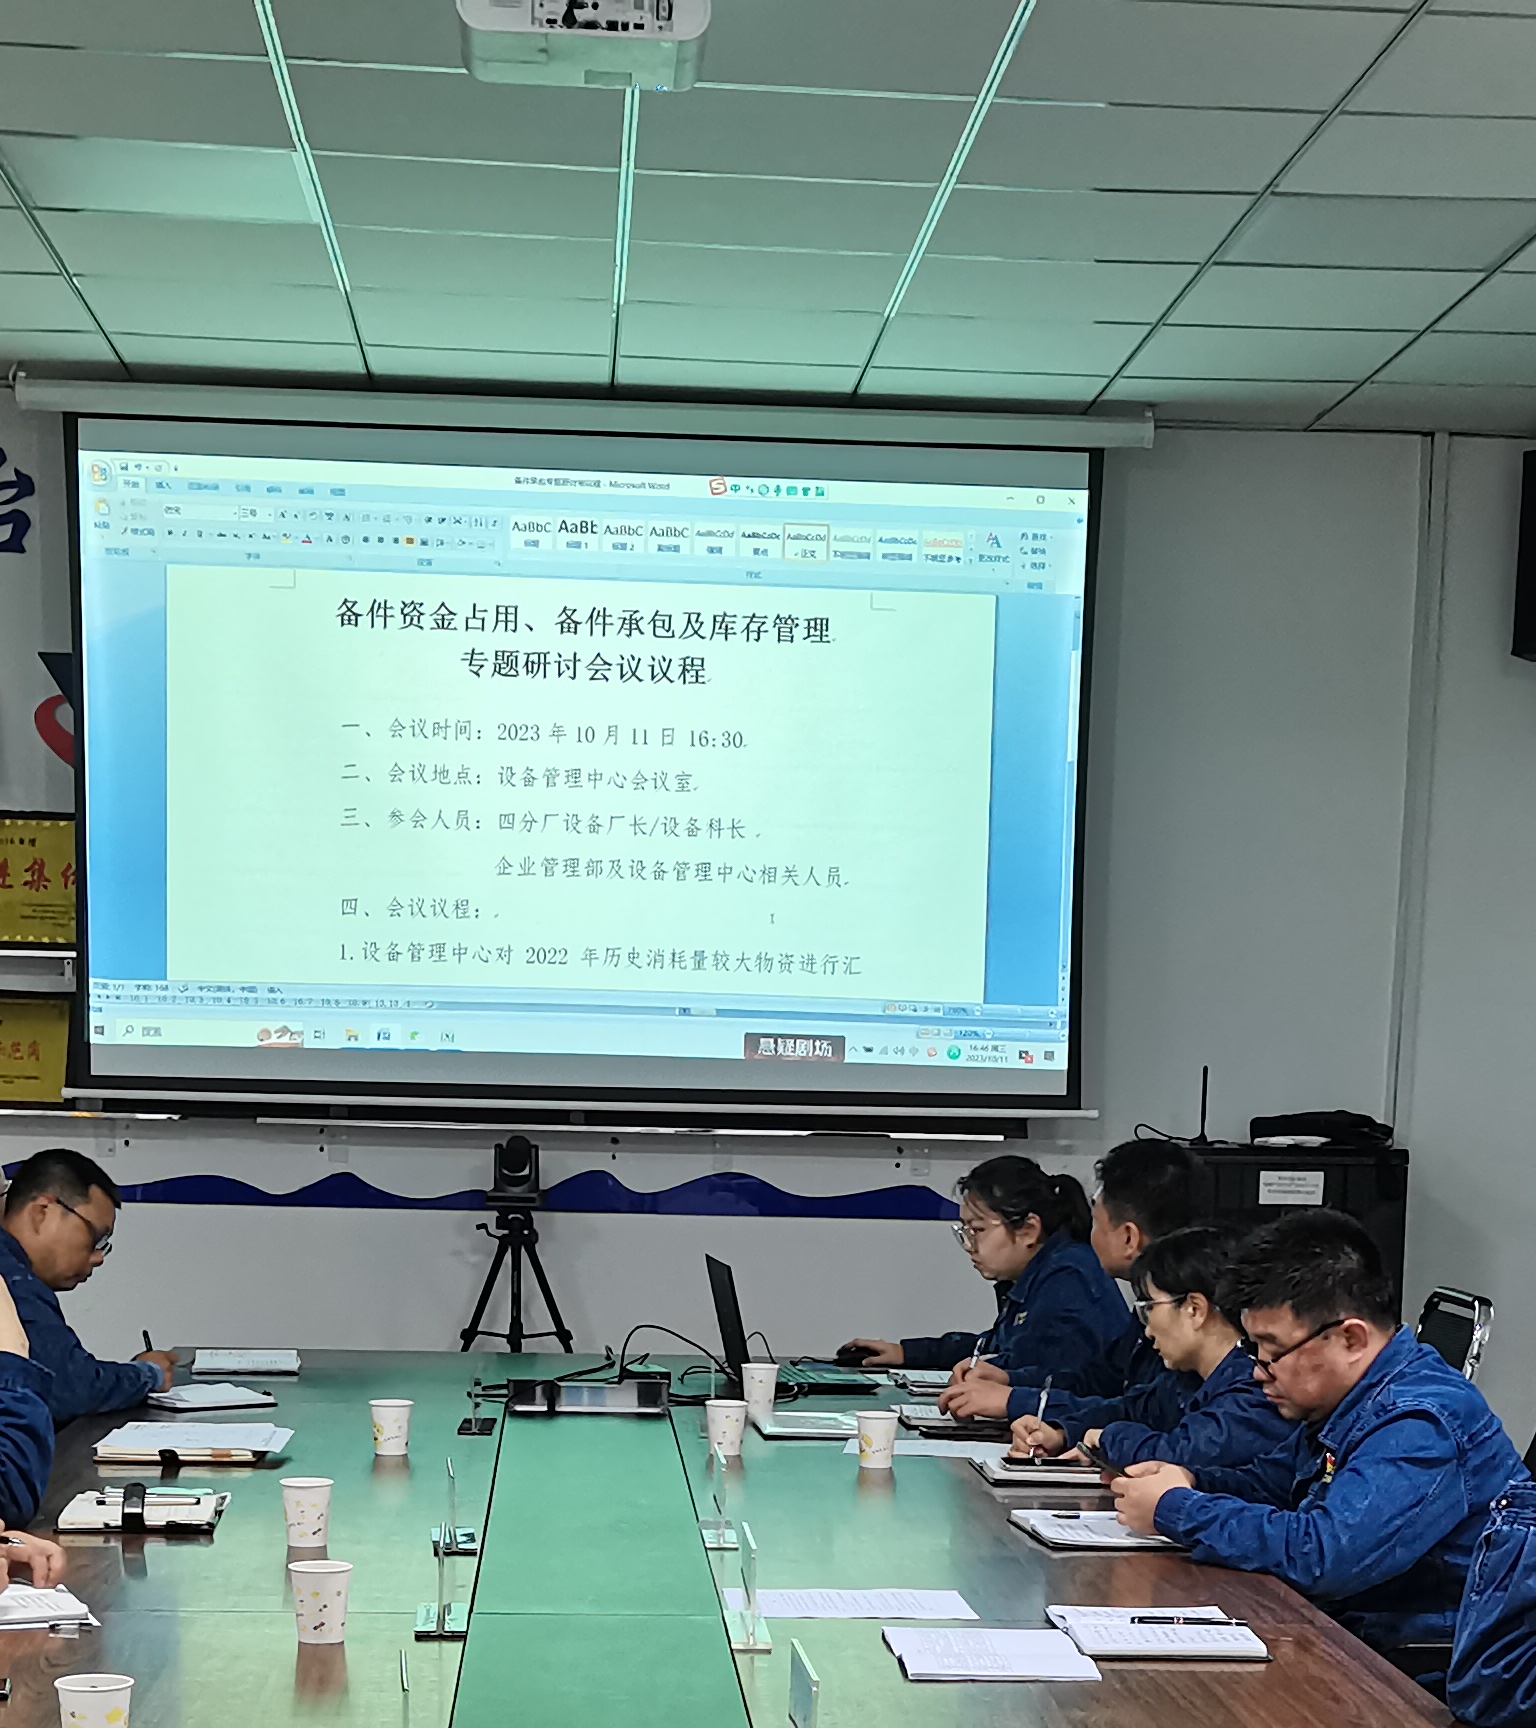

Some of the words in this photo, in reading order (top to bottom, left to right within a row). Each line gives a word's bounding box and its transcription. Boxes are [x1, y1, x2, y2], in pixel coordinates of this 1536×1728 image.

[609, 480, 647, 490] Microsoft
[648, 482, 671, 491] Word
[335, 597, 833, 644] 备件资金占用、备件承包及库存管理
[460, 647, 707, 686] 专题研讨会议议程
[689, 729, 744, 749] 16:30
[341, 762, 693, 794] 二、会议地点：设备管理中心会议室
[494, 854, 843, 889] 企业管理部及设备管理中心相关人员
[525, 946, 569, 966] 2022
[580, 945, 863, 977] 年历史消耗量较大物资进行汇
[757, 1036, 833, 1058] 悬疑剧场
